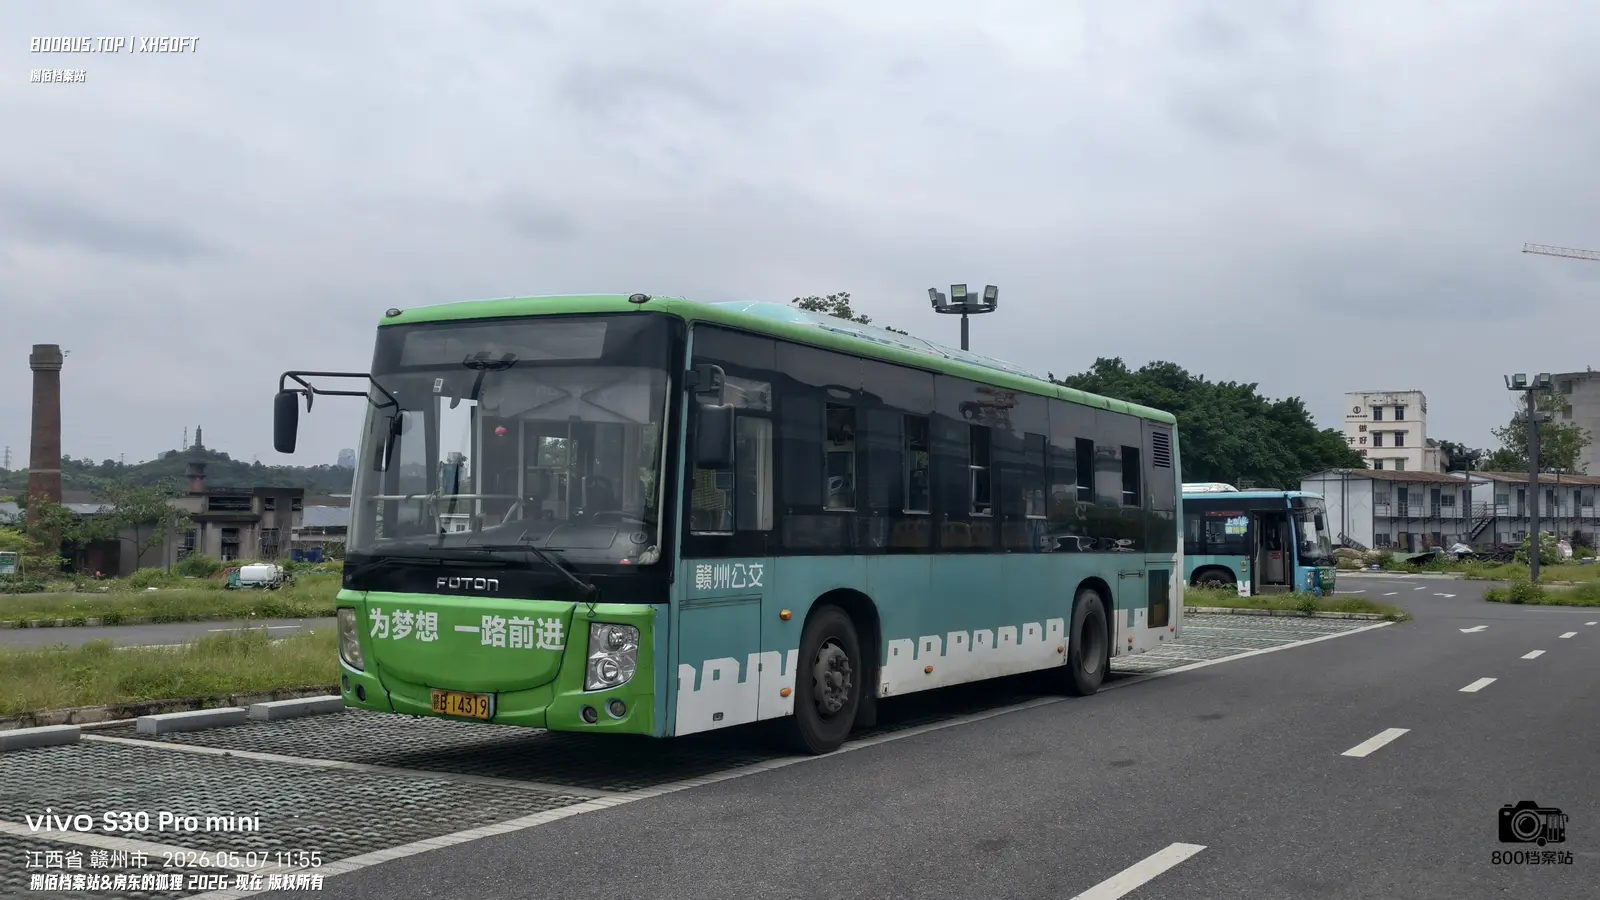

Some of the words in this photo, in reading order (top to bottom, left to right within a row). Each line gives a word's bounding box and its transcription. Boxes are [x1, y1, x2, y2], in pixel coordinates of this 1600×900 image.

[435, 576, 500, 592] FOTON
[695, 562, 764, 590] 赣州公交
[368, 607, 440, 643] 为梦想
[454, 615, 566, 651] 一路前进
